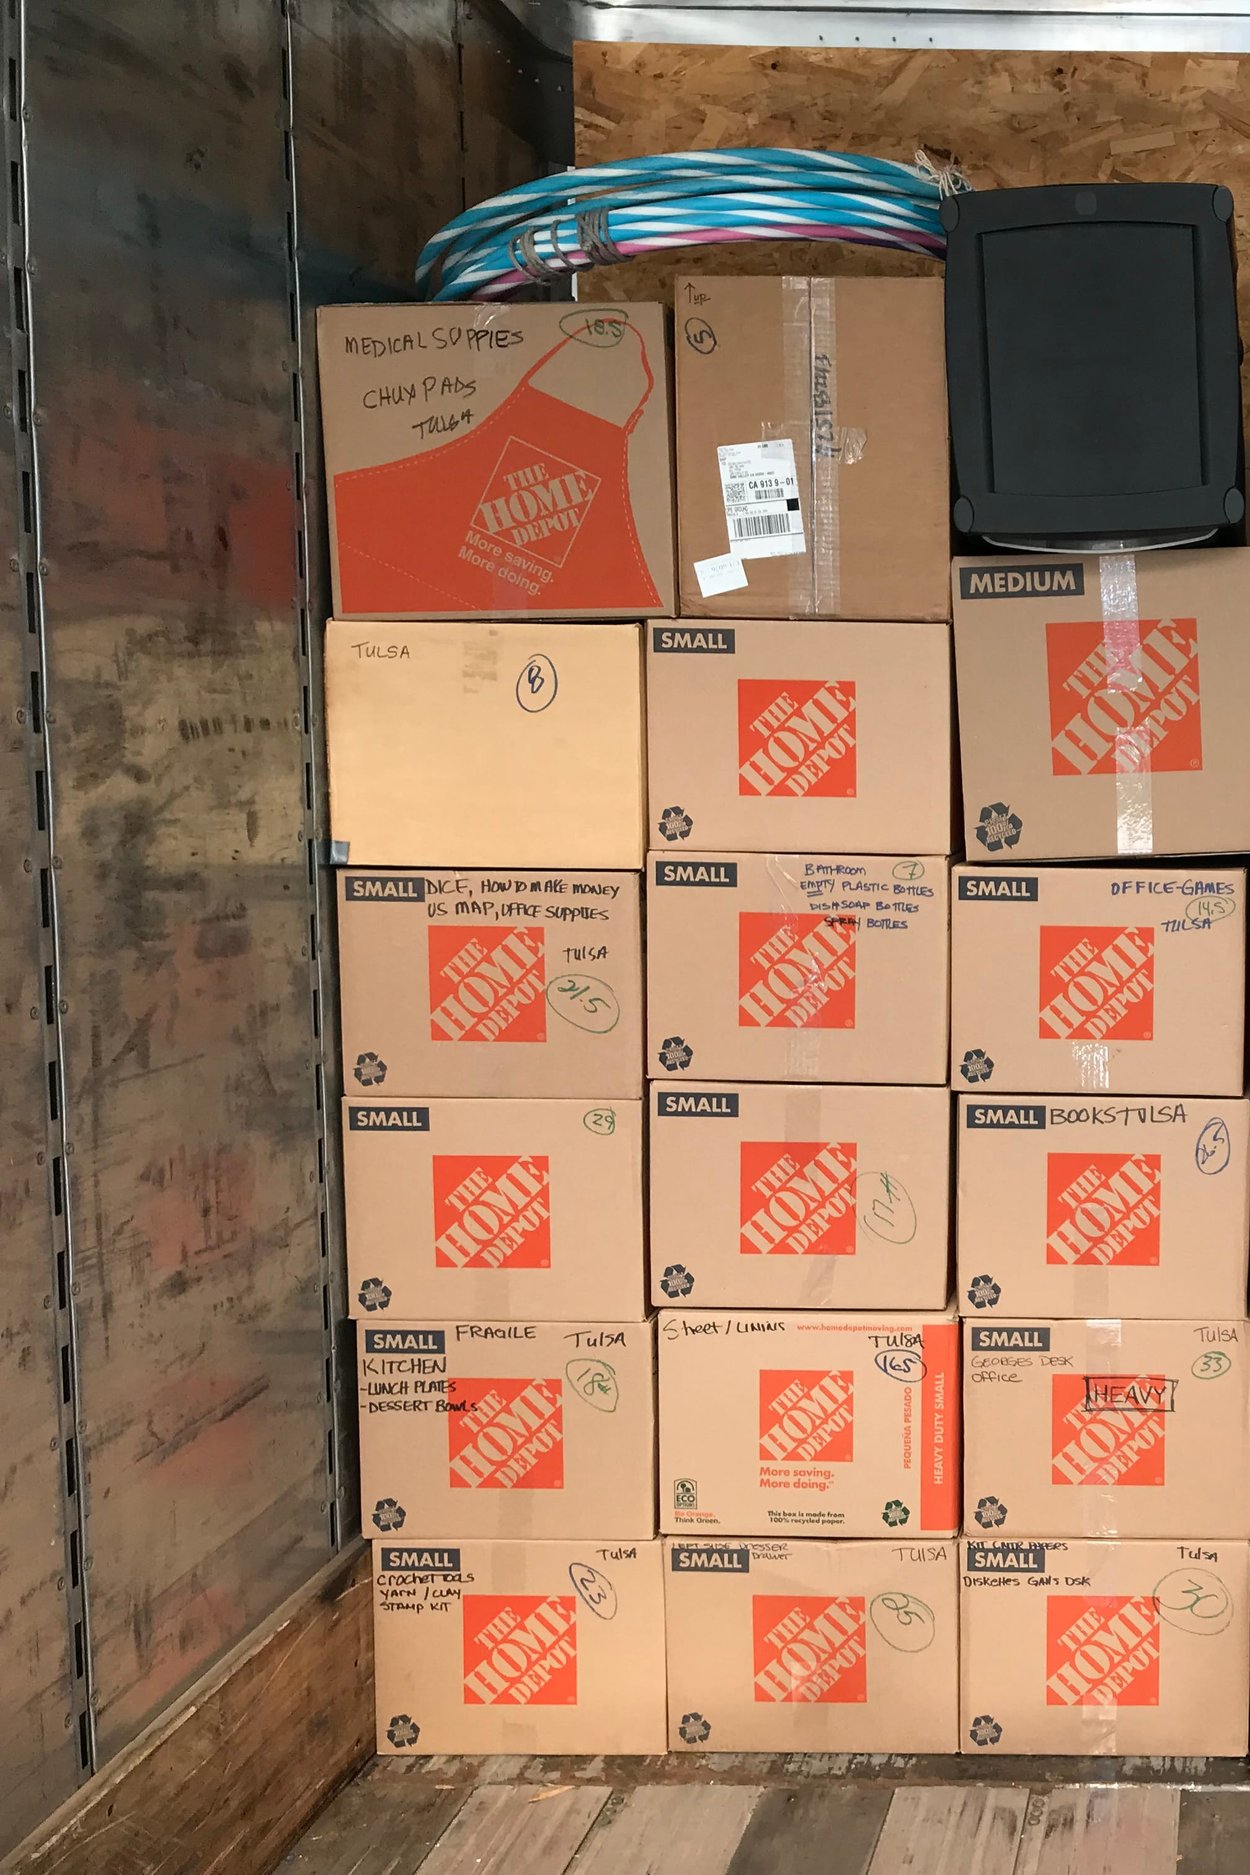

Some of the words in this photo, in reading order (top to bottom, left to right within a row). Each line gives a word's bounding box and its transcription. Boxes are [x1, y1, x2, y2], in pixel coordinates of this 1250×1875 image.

[345, 331, 428, 358] MEDICAL
[503, 462, 549, 491] THE
[479, 470, 594, 535] HOME
[512, 508, 581, 547] DEPOT
[458, 545, 497, 574] More
[497, 563, 543, 597] doing.
[465, 529, 504, 559] More
[503, 549, 555, 584] saving.
[969, 570, 1076, 594] MEDIUM
[350, 641, 411, 659] TULSA
[661, 632, 728, 649] SMALL
[1062, 641, 1116, 699] THE
[1051, 617, 1199, 774] HOME
[750, 691, 799, 739] THE
[1111, 674, 1200, 773] DEPOT
[739, 680, 856, 797] HOME
[784, 724, 856, 797] DEPOT
[353, 880, 419, 898] SMALL
[663, 865, 730, 883] SMALL
[841, 880, 890, 893] PLASTIC
[893, 883, 935, 898] BOTTLES
[966, 880, 1031, 898] SMALL
[427, 902, 449, 918] US
[440, 937, 488, 984] THE
[430, 926, 545, 1041] HOME
[475, 970, 547, 1042] DEPOT
[357, 1111, 422, 1127] SMALL
[665, 1096, 731, 1113] SMALL
[974, 1108, 1038, 1125] SMALL
[1050, 1106, 1116, 1125] BOOKS
[445, 1167, 493, 1213] THE
[434, 1155, 550, 1268] HOME
[480, 1197, 551, 1269] DEPOT
[373, 1333, 437, 1350] SMALL
[796, 1323, 913, 1333] www.homedepotmoving.com
[979, 1331, 1043, 1347] SMALL
[362, 1356, 447, 1377] KITCHEN
[768, 1379, 808, 1416] THE
[903, 1387, 912, 1425] PESADO
[934, 1372, 945, 1410] SMALL
[1094, 1385, 1167, 1404] HEAVY
[759, 1370, 854, 1462] HOME
[934, 1411, 945, 1444] DUTY
[796, 1404, 854, 1462] DEPOT
[760, 1467, 791, 1477] More
[793, 1467, 835, 1480] saving.
[933, 1446, 944, 1485] HEAVY
[760, 1479, 790, 1489] More
[793, 1479, 830, 1492] doing.
[389, 1552, 453, 1568] SMALL
[679, 1552, 742, 1568] SMALL
[975, 1552, 1038, 1568] SMALL
[430, 1602, 452, 1612] KIT
[763, 1607, 811, 1650] THE
[754, 1595, 867, 1702] HOME
[800, 1636, 867, 1703] DEPOT
